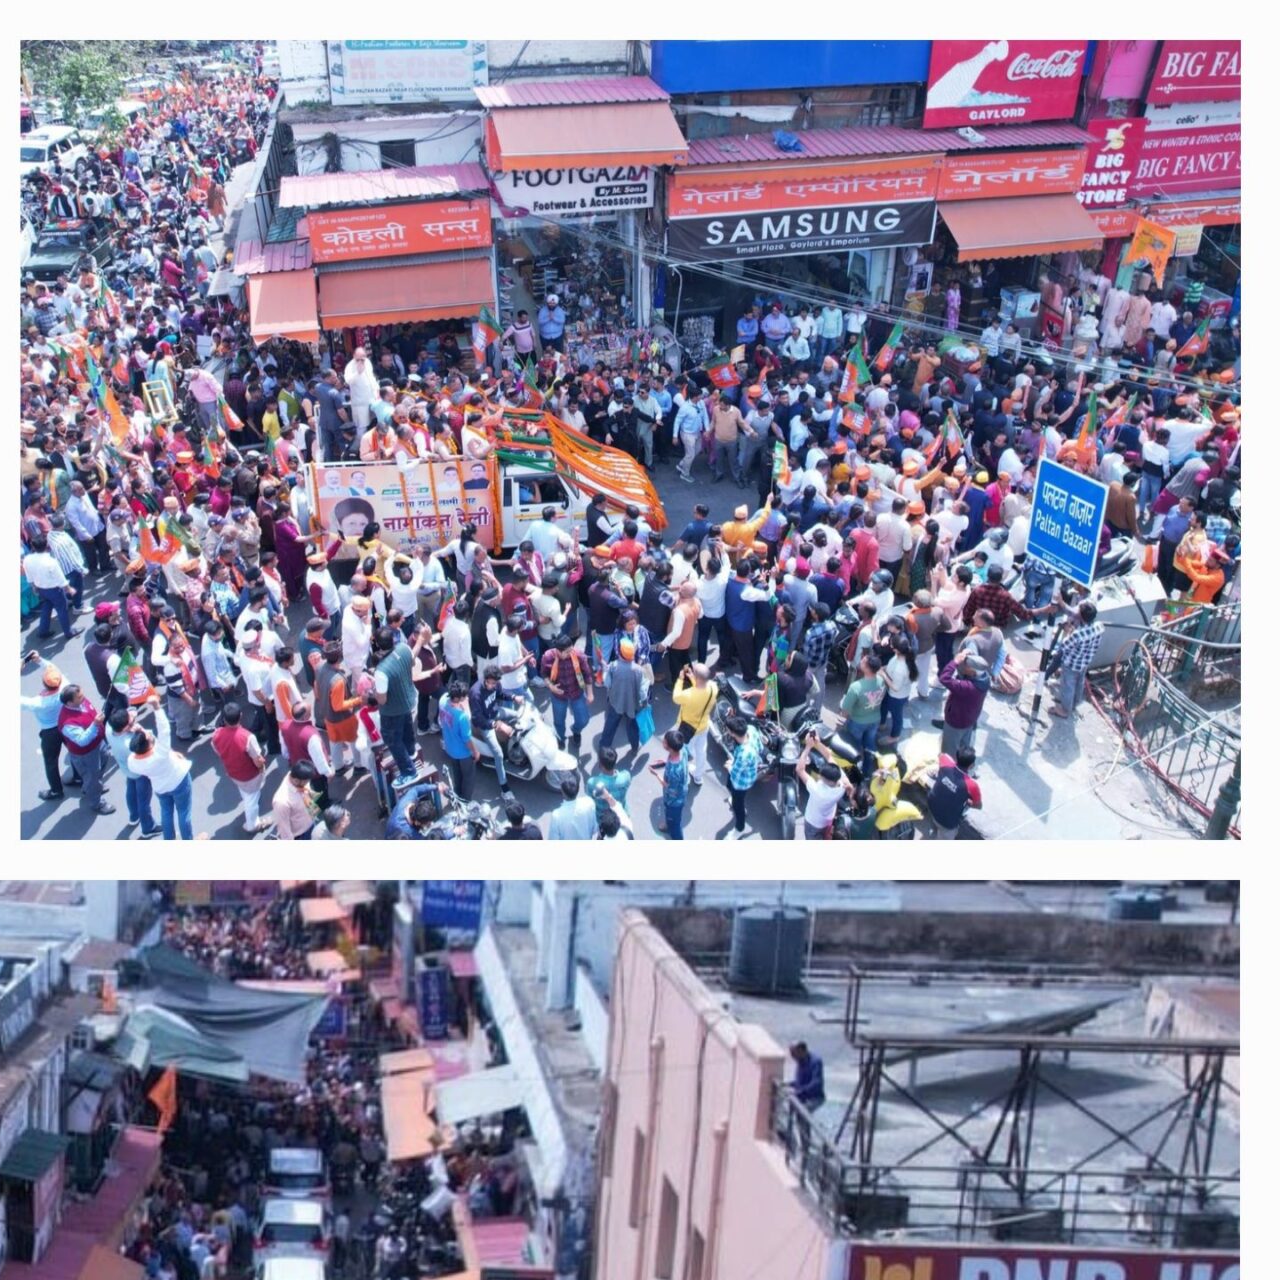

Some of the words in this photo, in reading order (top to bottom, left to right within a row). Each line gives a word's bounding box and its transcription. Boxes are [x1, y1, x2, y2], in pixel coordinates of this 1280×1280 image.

[1007, 50, 1084, 81] Coca-Cola
[1161, 52, 1206, 78] BIG
[969, 107, 1026, 120] GAYLORD
[1095, 153, 1125, 168] BIG
[1135, 157, 1169, 179] BIG
[1172, 151, 1236, 176] FANCY
[1081, 170, 1131, 186] FANCY
[624, 185, 644, 193] Sons
[1076, 189, 1127, 204] STORE
[533, 200, 577, 212] Footwear
[579, 198, 587, 208] &
[590, 196, 647, 207] Accessories
[321, 221, 406, 246] कोहली
[421, 218, 480, 237] सन्स
[706, 208, 901, 245] SAMSUNG
[736, 243, 760, 254] Smart
[831, 237, 871, 246] Emporium
[1035, 509, 1062, 540] Paltan
[1063, 523, 1093, 556] Bazaar
